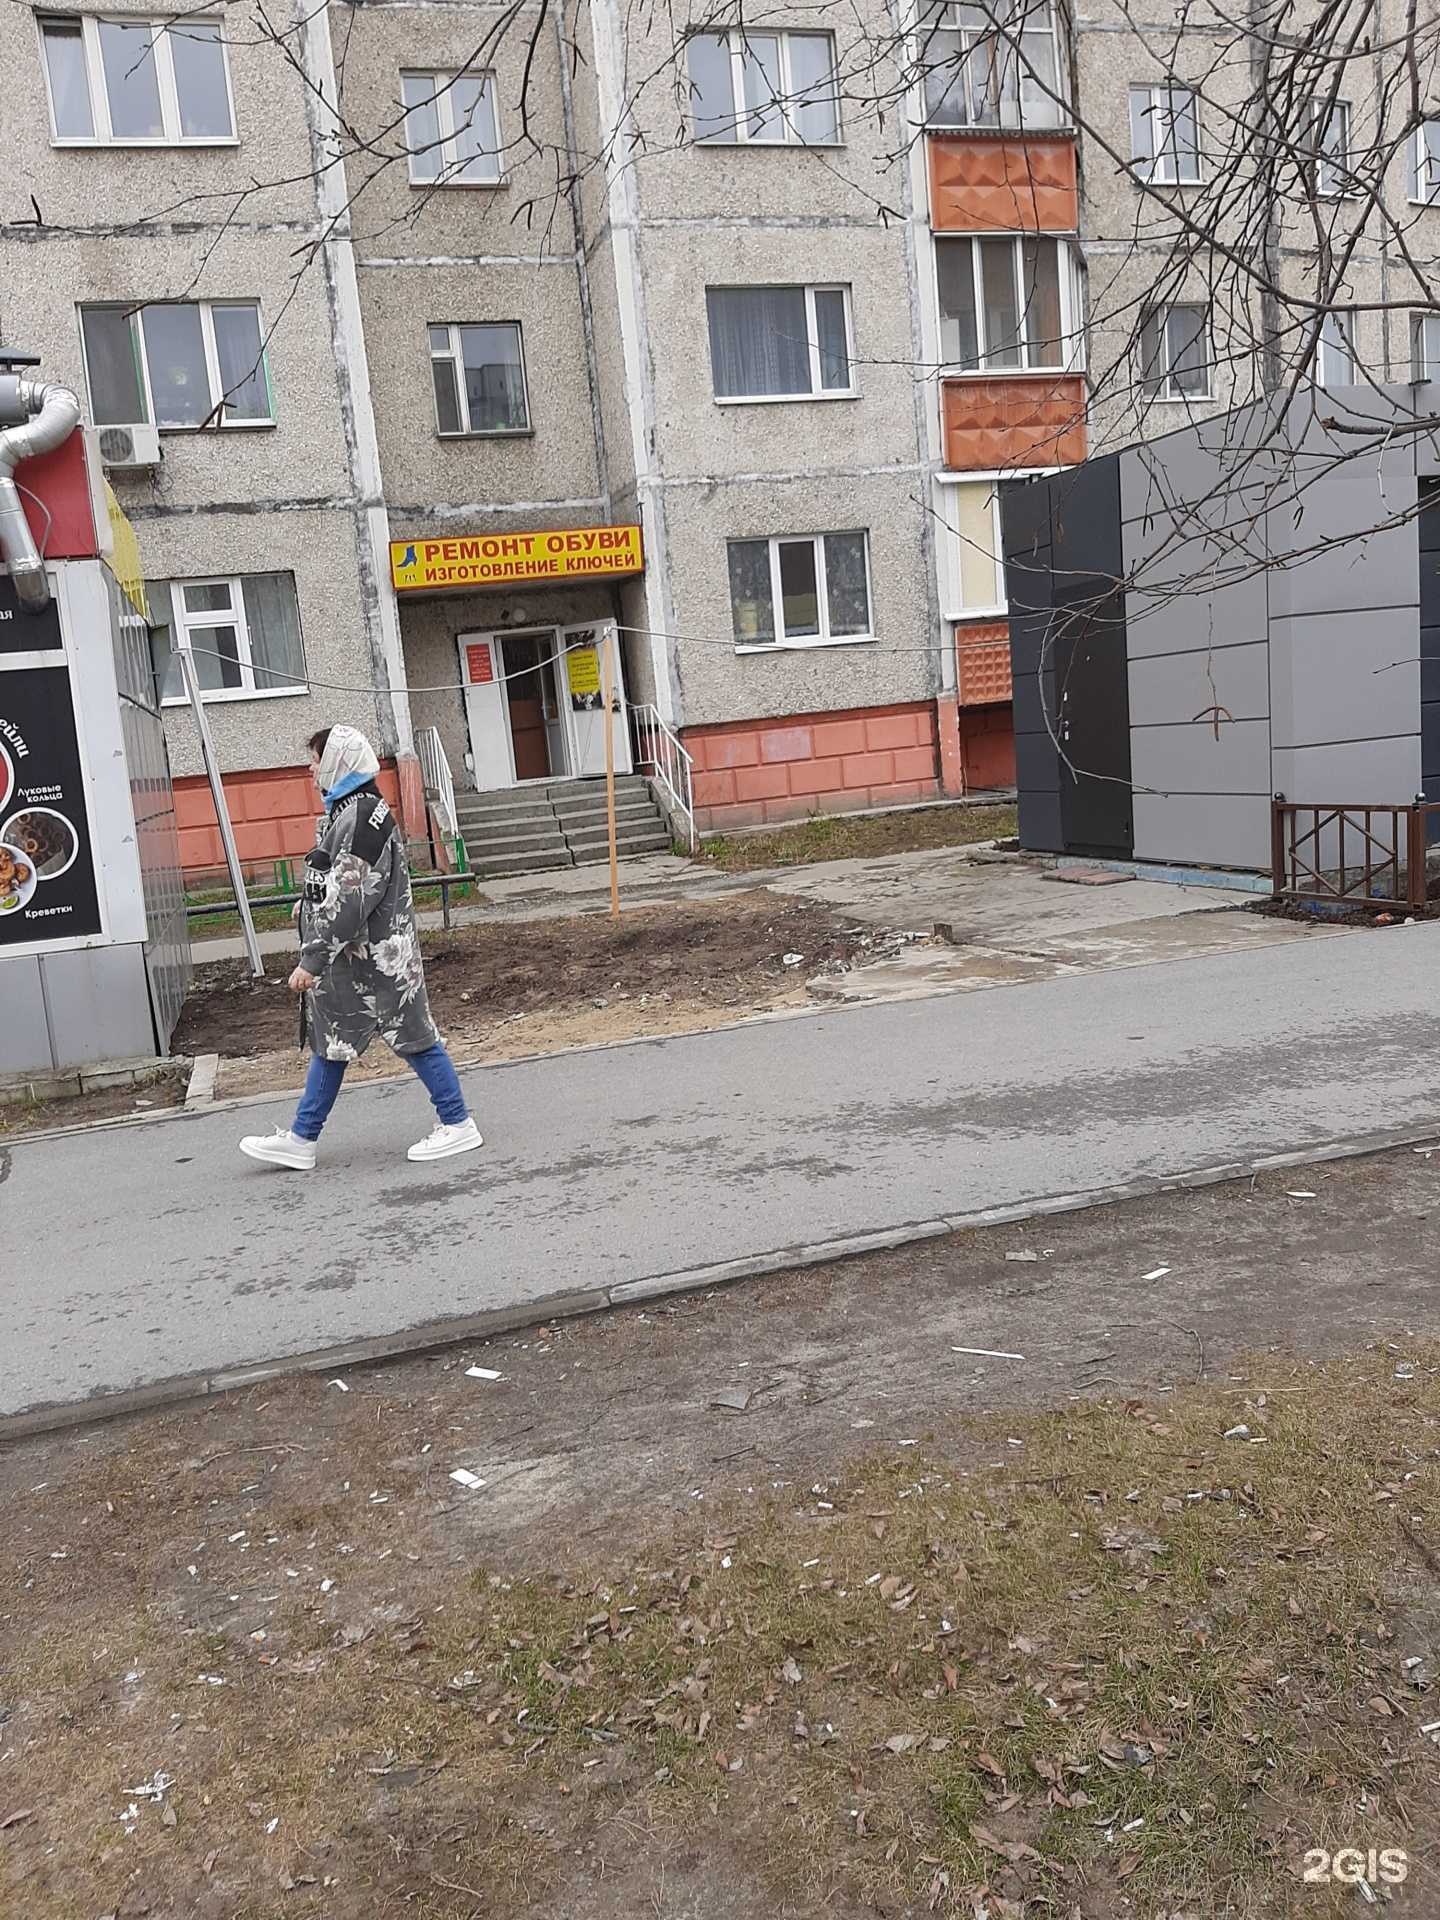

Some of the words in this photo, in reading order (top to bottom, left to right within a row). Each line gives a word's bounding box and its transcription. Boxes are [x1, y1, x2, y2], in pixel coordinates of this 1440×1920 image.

[424, 537, 536, 562] РЕМОНТ
[546, 530, 631, 553] ОБУВИ
[425, 560, 558, 581] ИЗГОТОВЛЕНИЕ
[566, 550, 636, 571] КЛЮЧЕЙ
[17, 785, 61, 798] Луковые
[27, 792, 63, 803] кольца
[24, 905, 73, 919] Креветки
